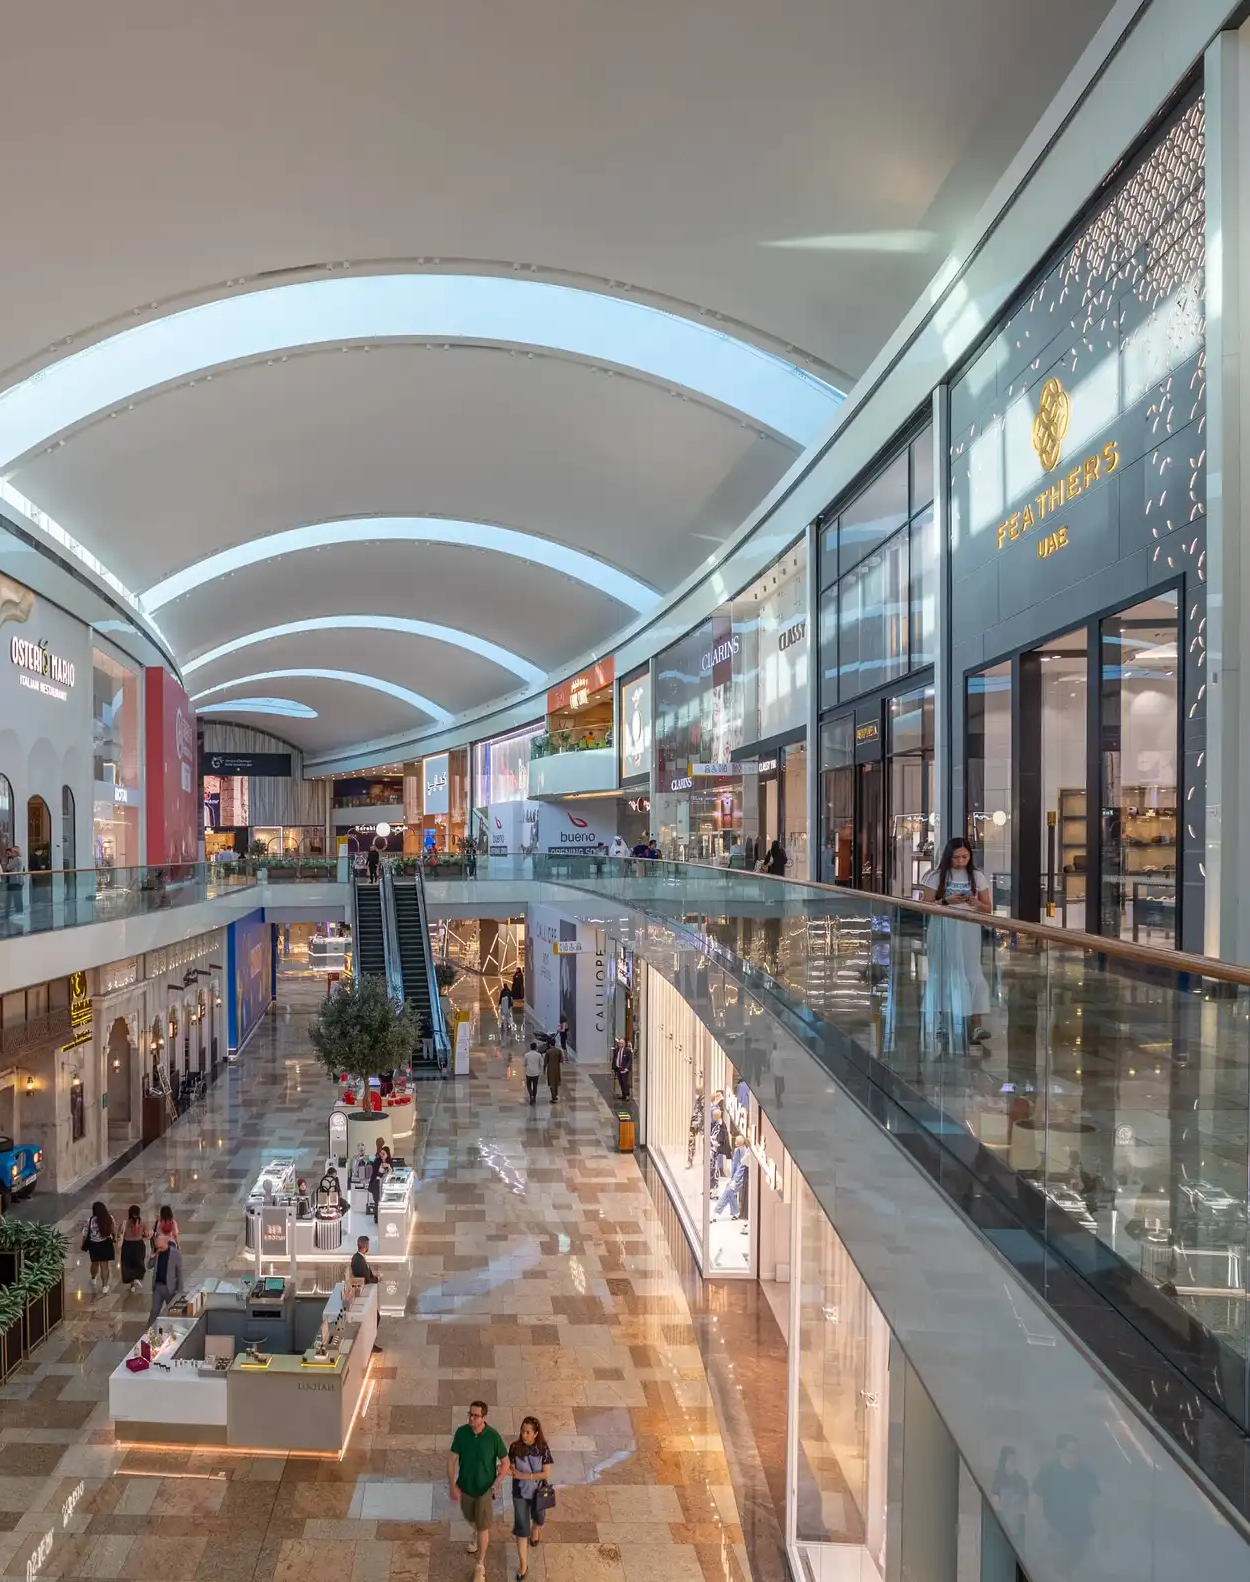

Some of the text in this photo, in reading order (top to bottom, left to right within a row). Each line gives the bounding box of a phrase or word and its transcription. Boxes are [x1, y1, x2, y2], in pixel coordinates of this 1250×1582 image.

[997, 441, 1119, 549] FEATHERS
[1037, 525, 1069, 559] UAE
[701, 635, 740, 671] CLARINS
[778, 623, 806, 652] CLASSY
[50, 654, 75, 688] MARIO
[561, 832, 596, 842] bueno
